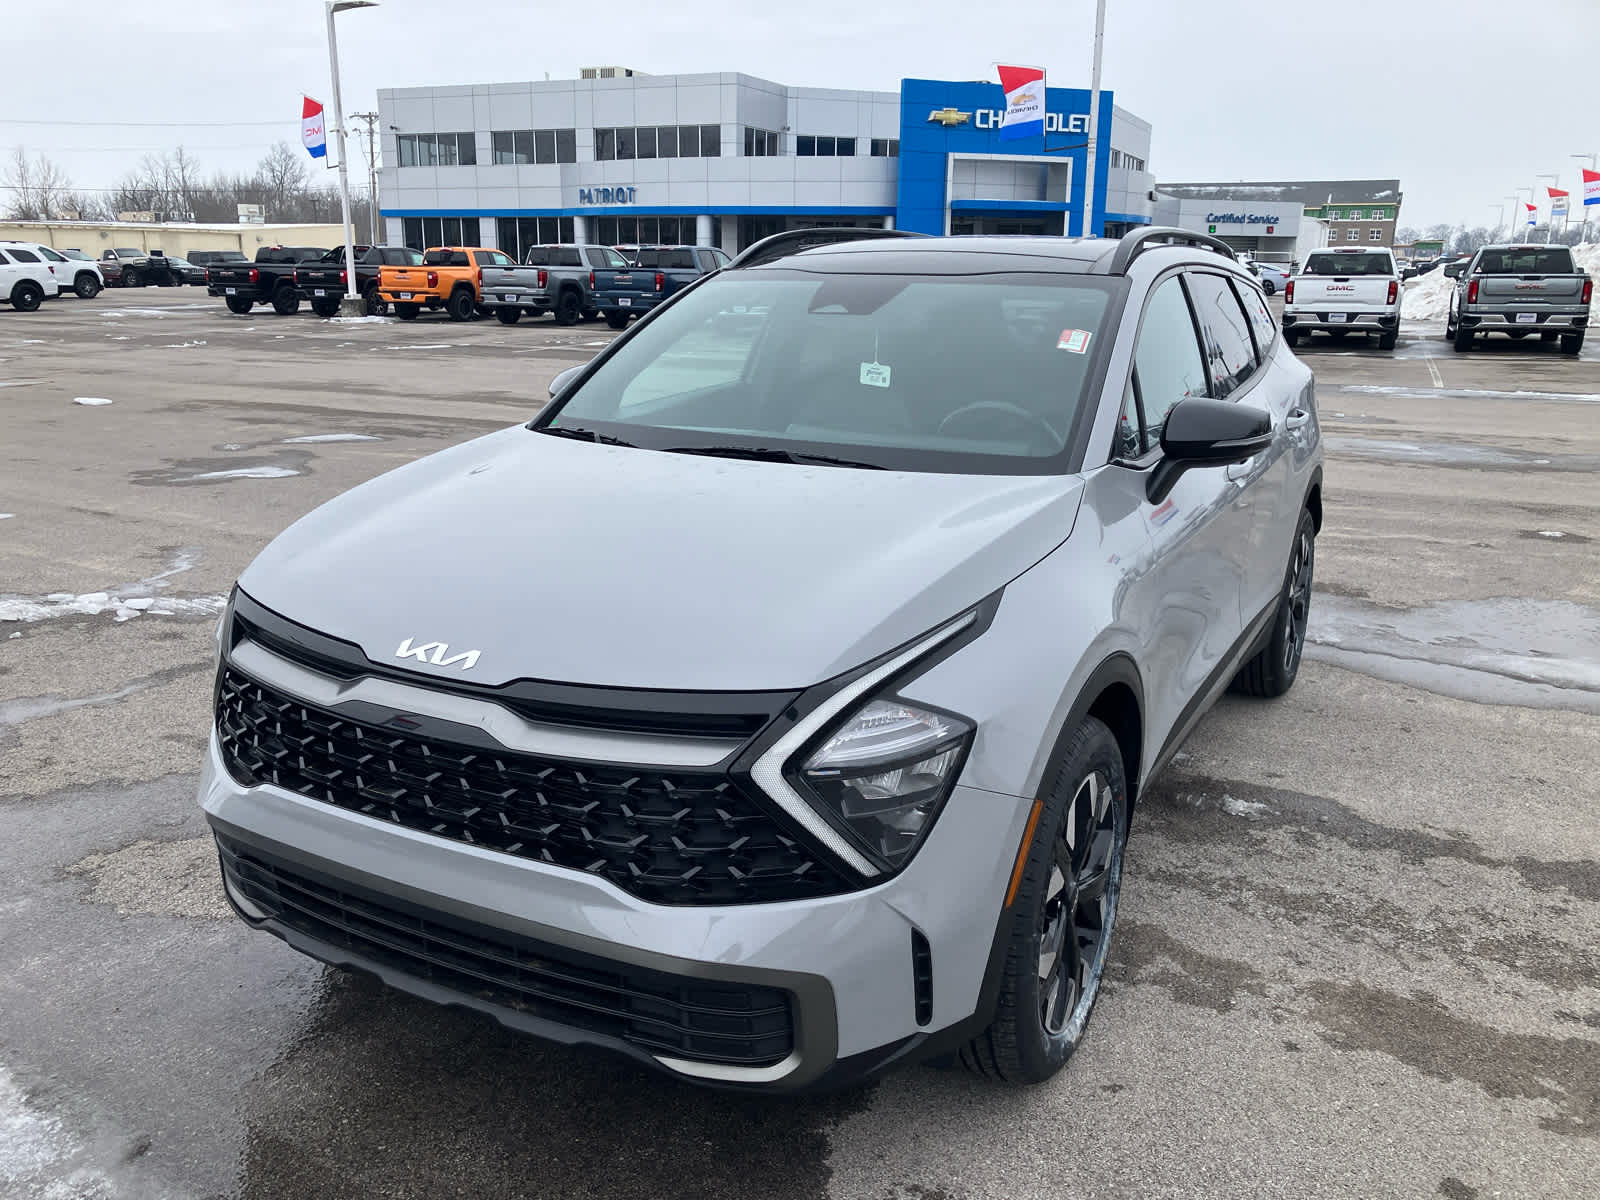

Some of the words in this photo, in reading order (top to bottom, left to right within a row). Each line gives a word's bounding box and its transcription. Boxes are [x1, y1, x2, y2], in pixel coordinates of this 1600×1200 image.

[975, 108, 1091, 133] CHOLET
[579, 186, 636, 204] PATRIOT
[1207, 213, 1246, 224] Certified
[1246, 214, 1280, 225] Service
[395, 637, 481, 670] KIA
